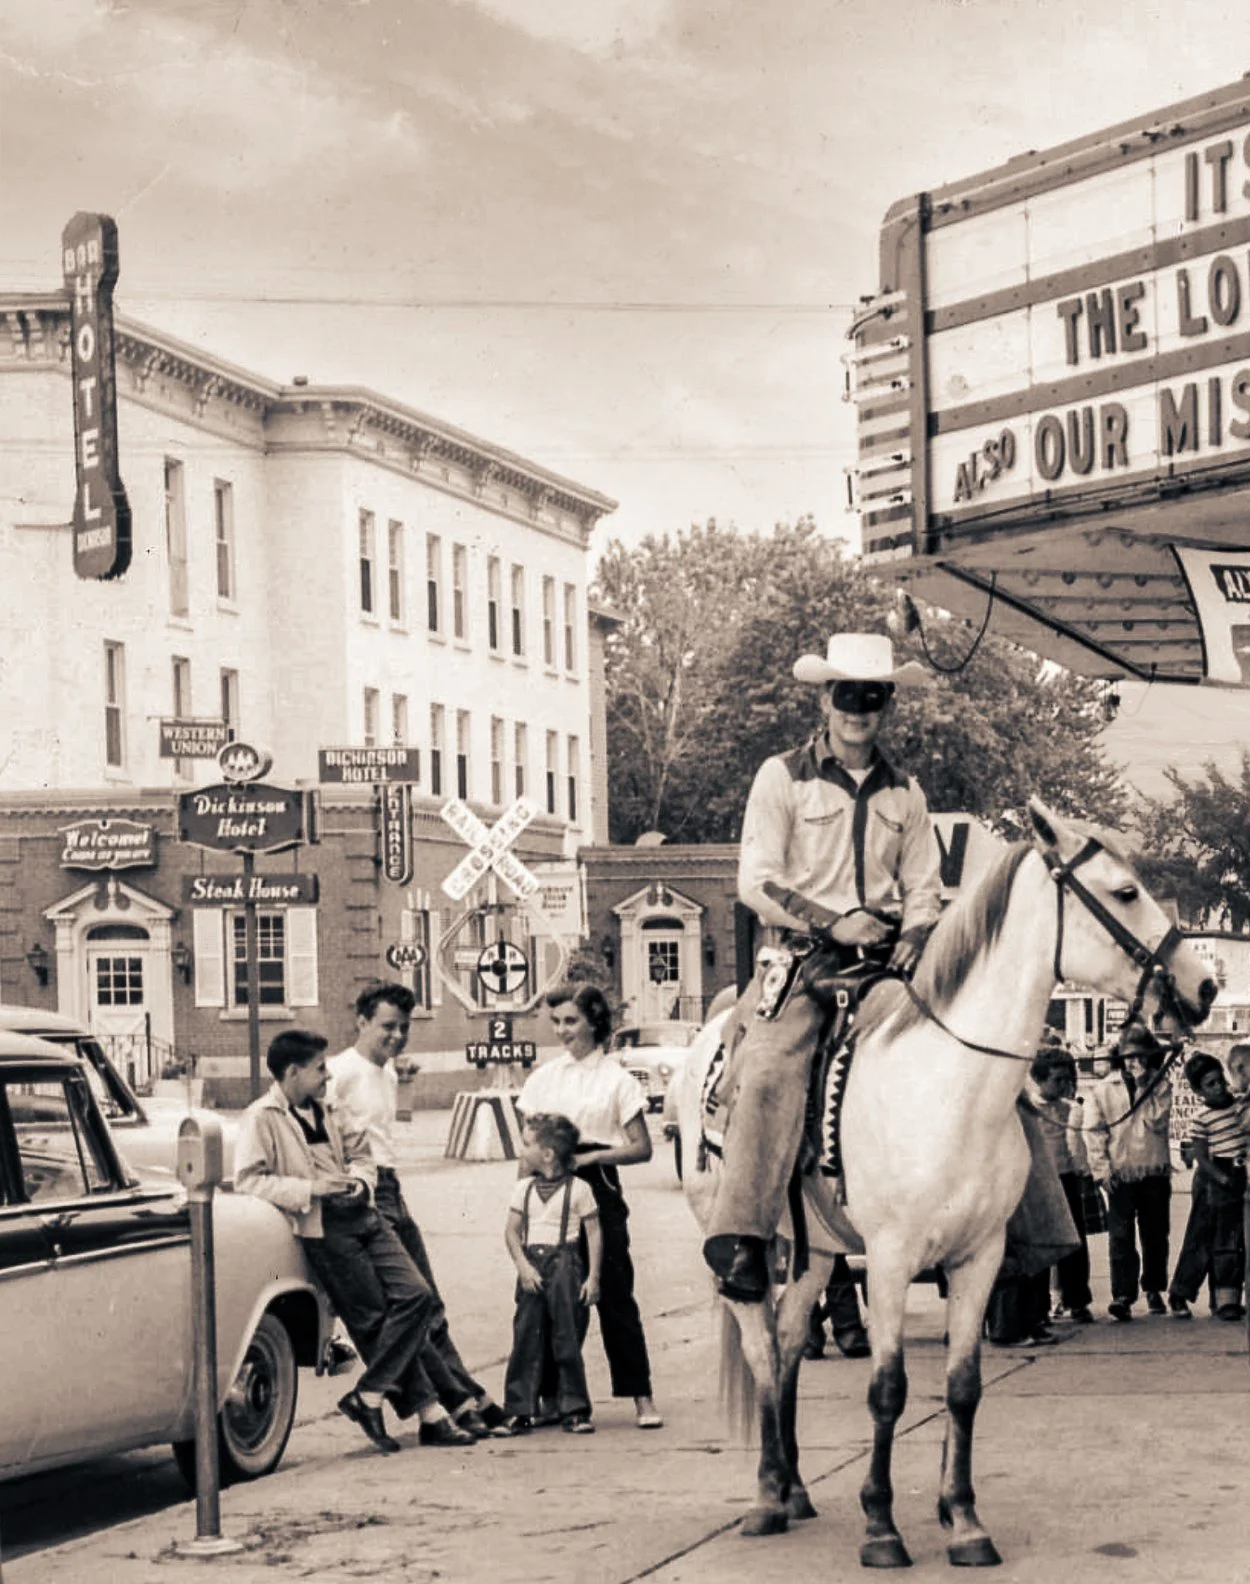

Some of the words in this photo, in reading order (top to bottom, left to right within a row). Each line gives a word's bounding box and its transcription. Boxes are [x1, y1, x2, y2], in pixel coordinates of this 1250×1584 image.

[1057, 281, 1148, 366] THE
[76, 272, 102, 520] HOTEL
[954, 427, 1017, 500] ALSO
[1034, 402, 1129, 481] OUR
[163, 727, 225, 740] WESTERN
[171, 741, 217, 754] UNION
[342, 765, 387, 781] HOTEL
[193, 795, 287, 815] Dickinson
[217, 817, 267, 838] Hotel
[191, 877, 245, 899] Steak
[249, 876, 299, 899] House
[493, 1020, 507, 1039] 2
[467, 1044, 534, 1061] TRACKS
